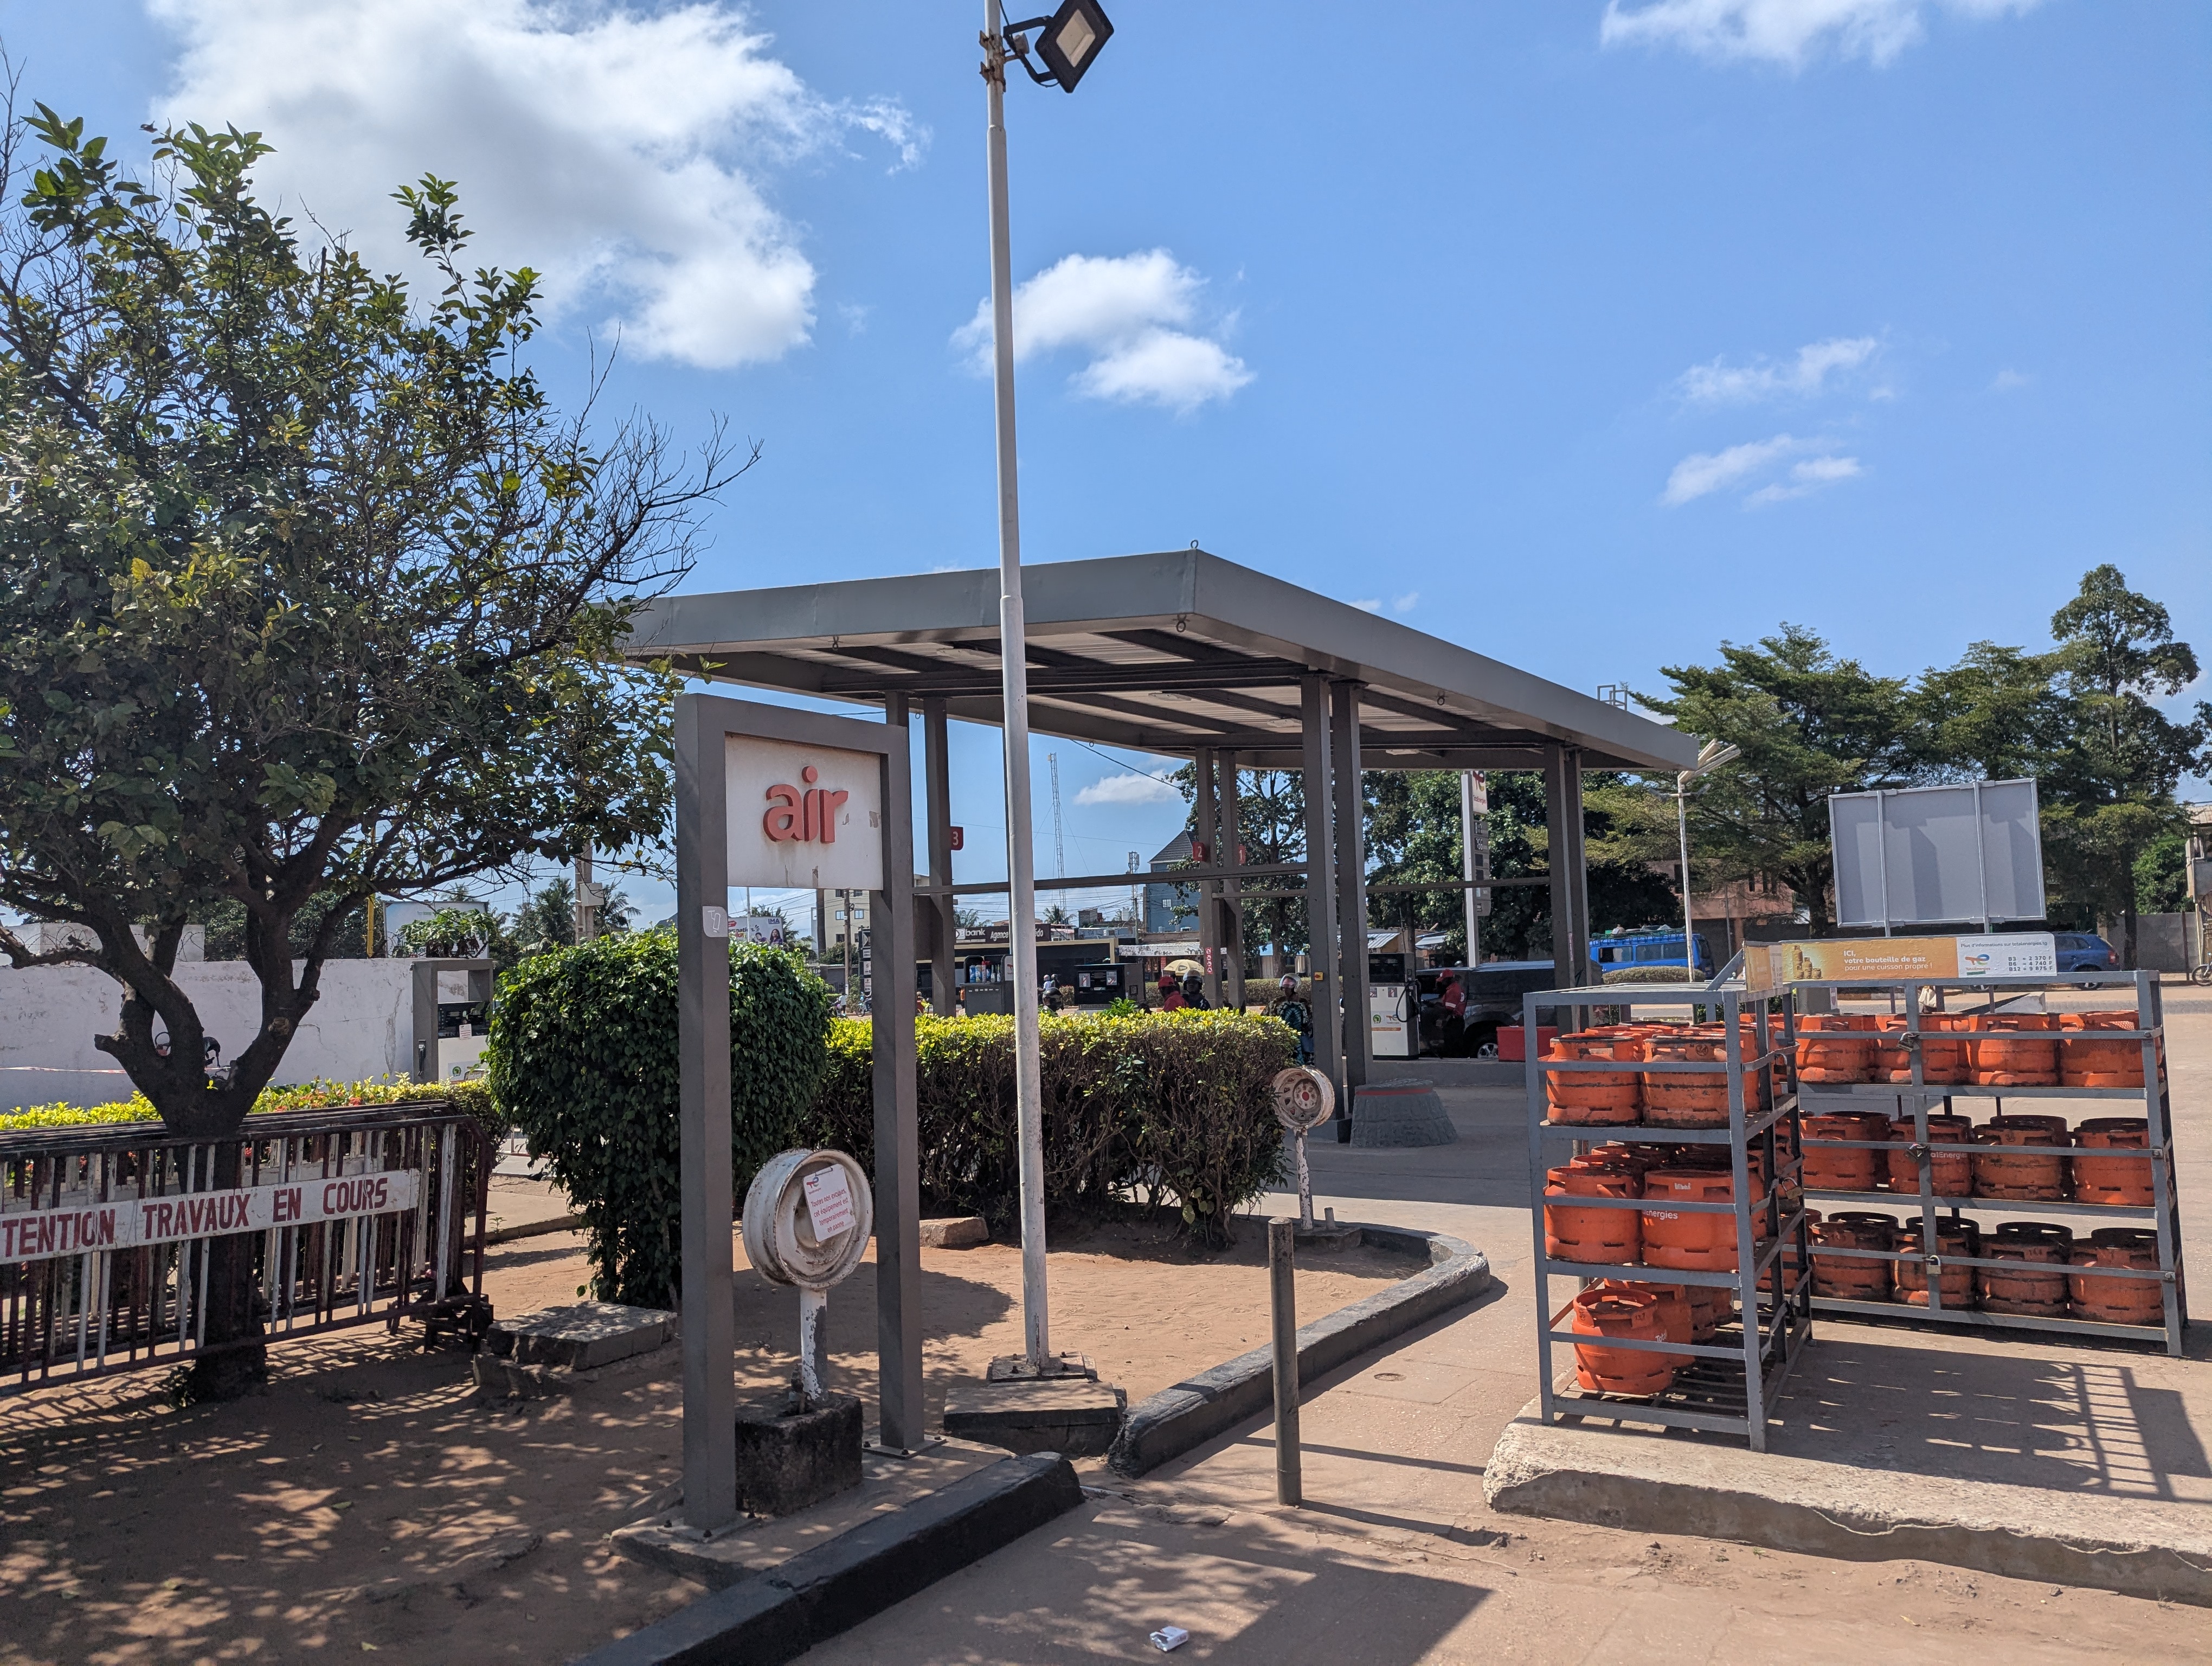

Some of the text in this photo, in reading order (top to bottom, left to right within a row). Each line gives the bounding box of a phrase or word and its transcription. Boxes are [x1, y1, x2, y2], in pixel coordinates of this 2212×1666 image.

[763, 765, 849, 844] air
[953, 831, 959, 845] 3
[1198, 846, 1203, 858] 2
[1239, 849, 1243, 860] 1
[990, 931, 1008, 941] Agence
[811, 1198, 824, 1207] Toutes
[0, 1177, 388, 1258] TENTION TRAVAUX EN COURS
[833, 1221, 844, 1231] panne
